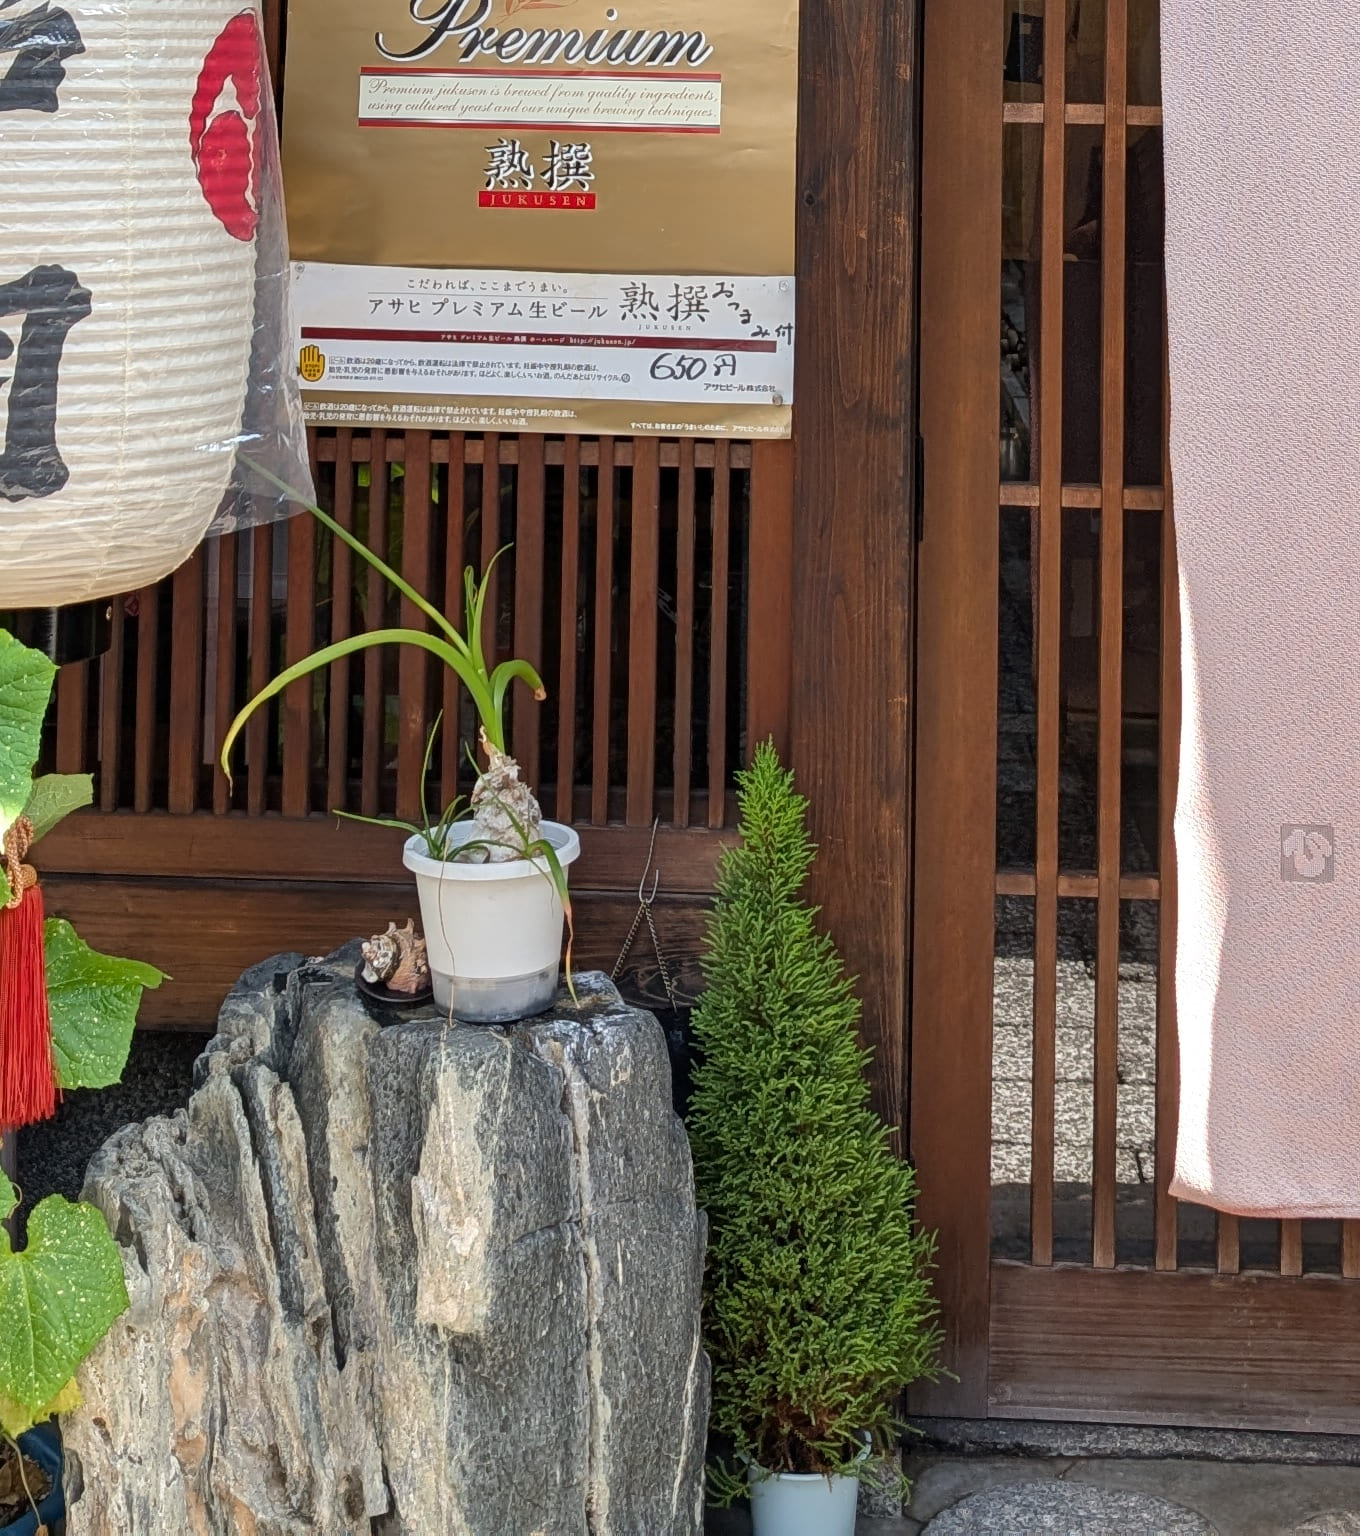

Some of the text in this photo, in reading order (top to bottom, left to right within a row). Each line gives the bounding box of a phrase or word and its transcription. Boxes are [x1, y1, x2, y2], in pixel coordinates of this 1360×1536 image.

[368, 78, 718, 104] Premium jukusen is brewed from quality ingredients,
[368, 99, 717, 121] using cultured yeast and our unique brewing techniques.
[484, 137, 595, 192] 熟撰
[490, 194, 587, 207] JUKUSEN
[407, 278, 569, 295] こだわれば、ここまでうまい。
[368, 281, 711, 323] アサヒ プレミアム生ビール 熟撰
[638, 324, 692, 332] JUKUSEN
[704, 383, 777, 393] アサヒビール株式会社
